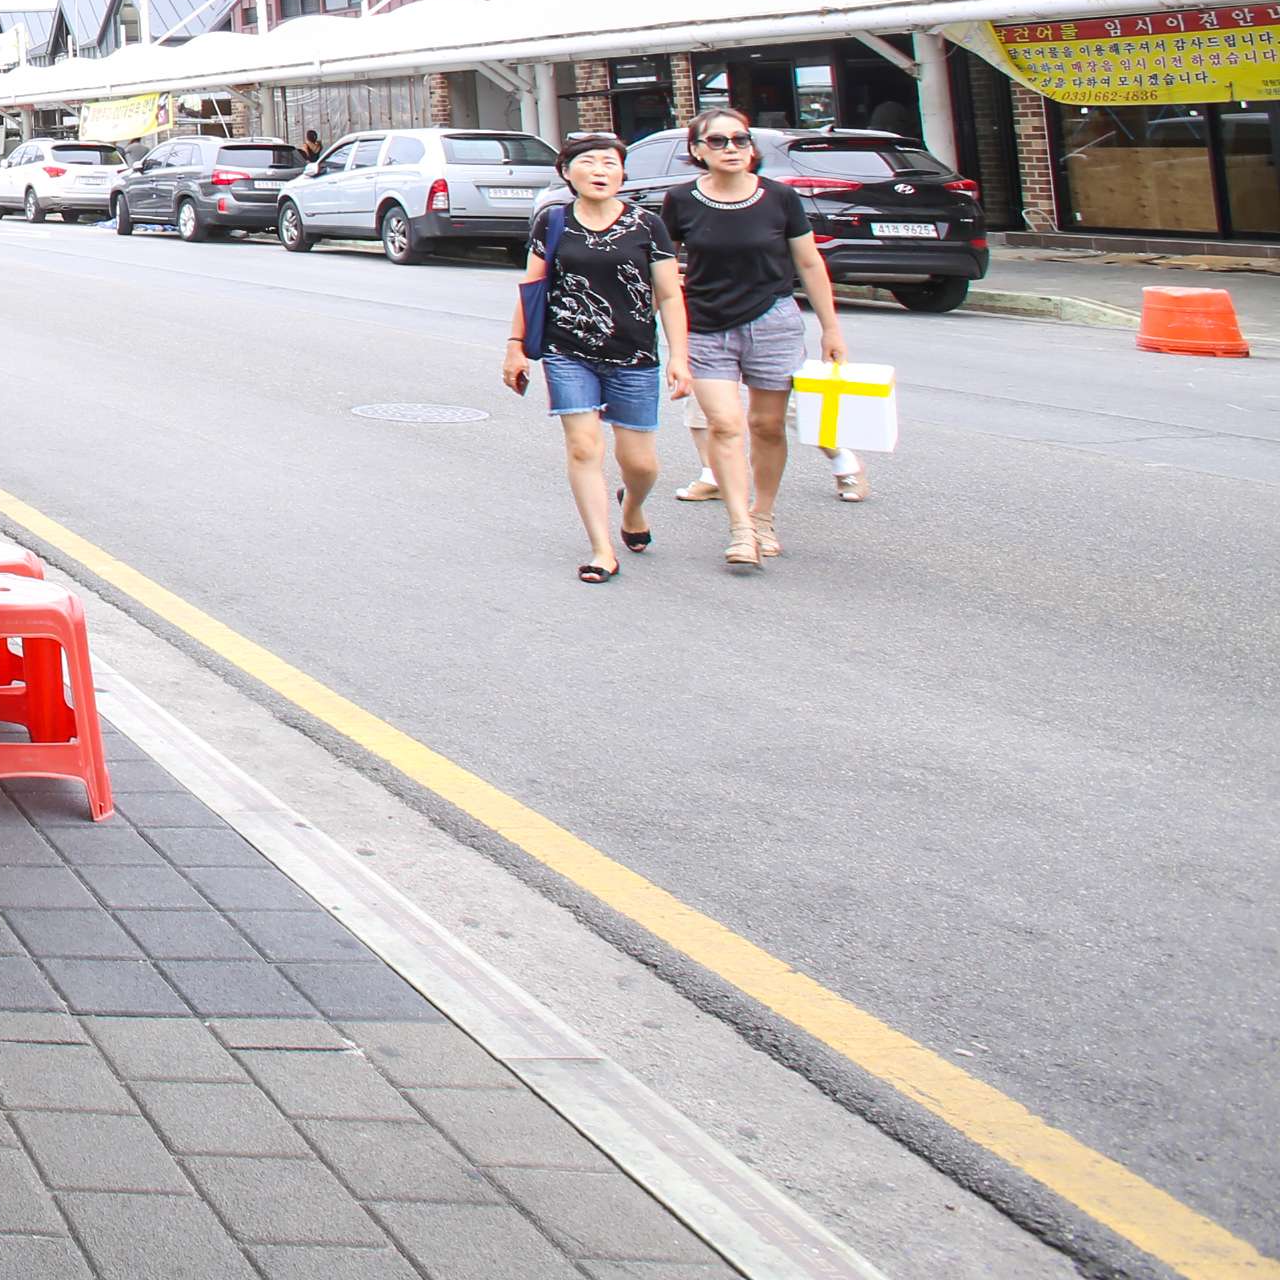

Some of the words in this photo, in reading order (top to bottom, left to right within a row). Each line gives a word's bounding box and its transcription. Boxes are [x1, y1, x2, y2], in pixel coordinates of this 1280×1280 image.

[1072, 60, 1113, 73] 매장을
[1119, 57, 1147, 71] 임시
[1154, 55, 1183, 68] 이전
[1073, 75, 1111, 88] 다하여
[902, 224, 933, 237] 9625
